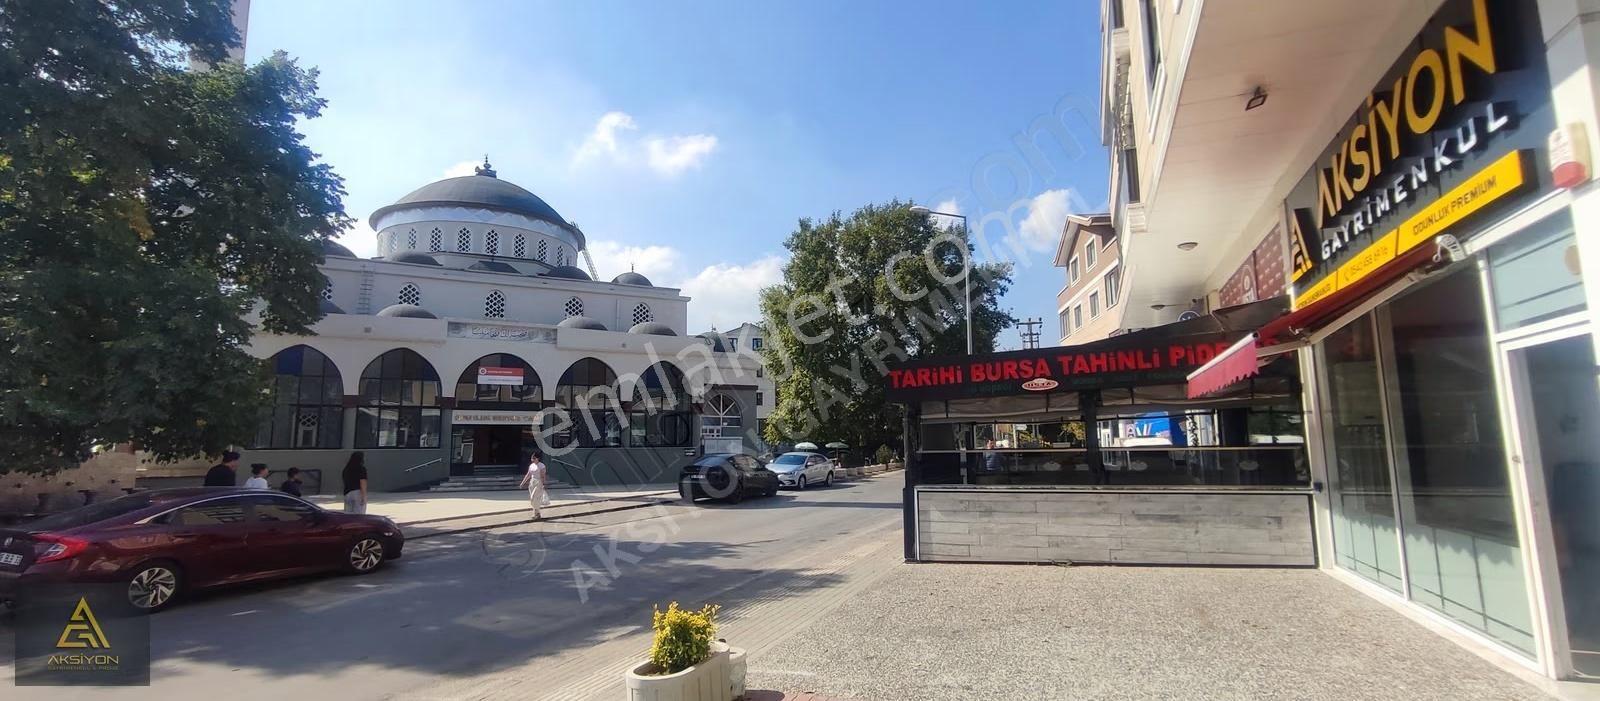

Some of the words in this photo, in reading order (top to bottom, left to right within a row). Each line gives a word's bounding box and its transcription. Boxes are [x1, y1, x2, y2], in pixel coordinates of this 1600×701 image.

[1317, 0, 1496, 229] AKSİYON
[1320, 101, 1510, 261] GAYRİMENKUL
[971, 358, 1052, 383] BURSA
